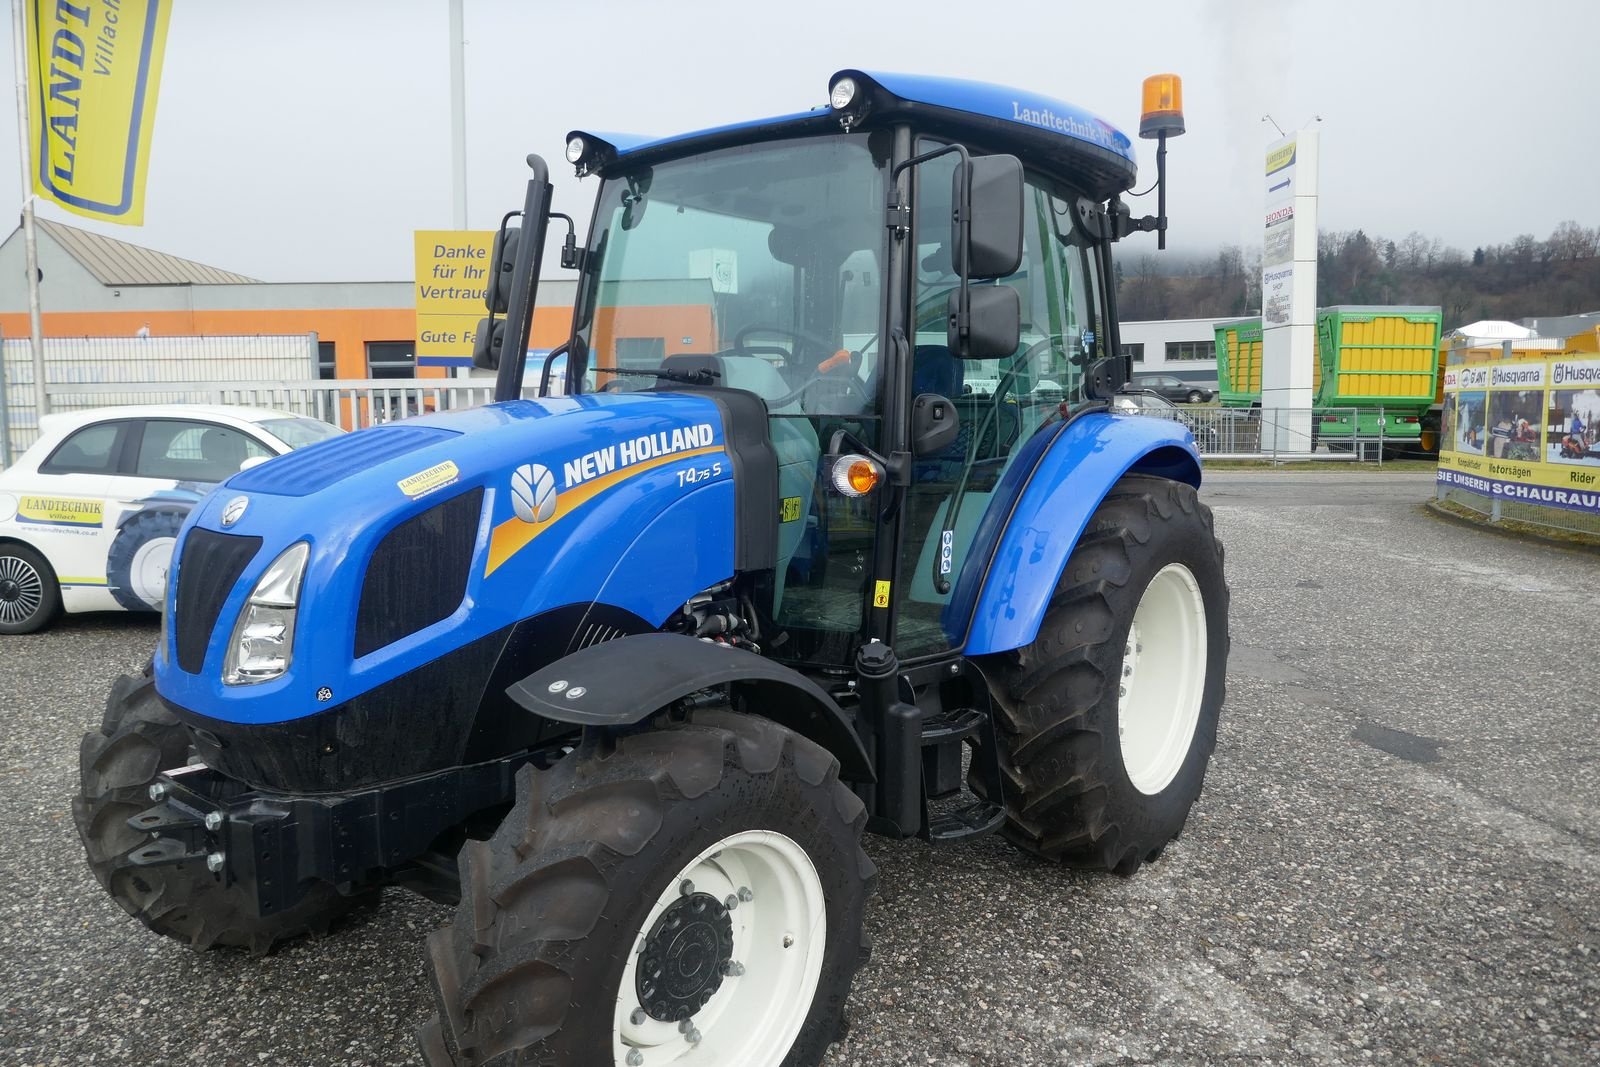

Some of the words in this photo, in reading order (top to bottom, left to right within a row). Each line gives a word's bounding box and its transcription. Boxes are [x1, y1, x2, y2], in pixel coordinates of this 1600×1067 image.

[1265, 206, 1294, 223] HONDA
[433, 244, 486, 259] Danke
[432, 264, 457, 279] für
[463, 265, 486, 279] Ihr
[420, 330, 457, 343] Gute
[1497, 368, 1540, 384] Husqvarna
[563, 445, 616, 488] NEW
[619, 423, 714, 467] HOLLAND
[712, 462, 722, 477] S
[1488, 463, 1532, 478] Motorsägen
[1570, 471, 1596, 484] Rider
[1437, 471, 1452, 482] SIE
[1453, 473, 1490, 492] UNSEREN
[1491, 483, 1600, 509] SCHAURAU
[26, 499, 102, 514] LANDTECHNIK
[49, 513, 76, 521] Villach
